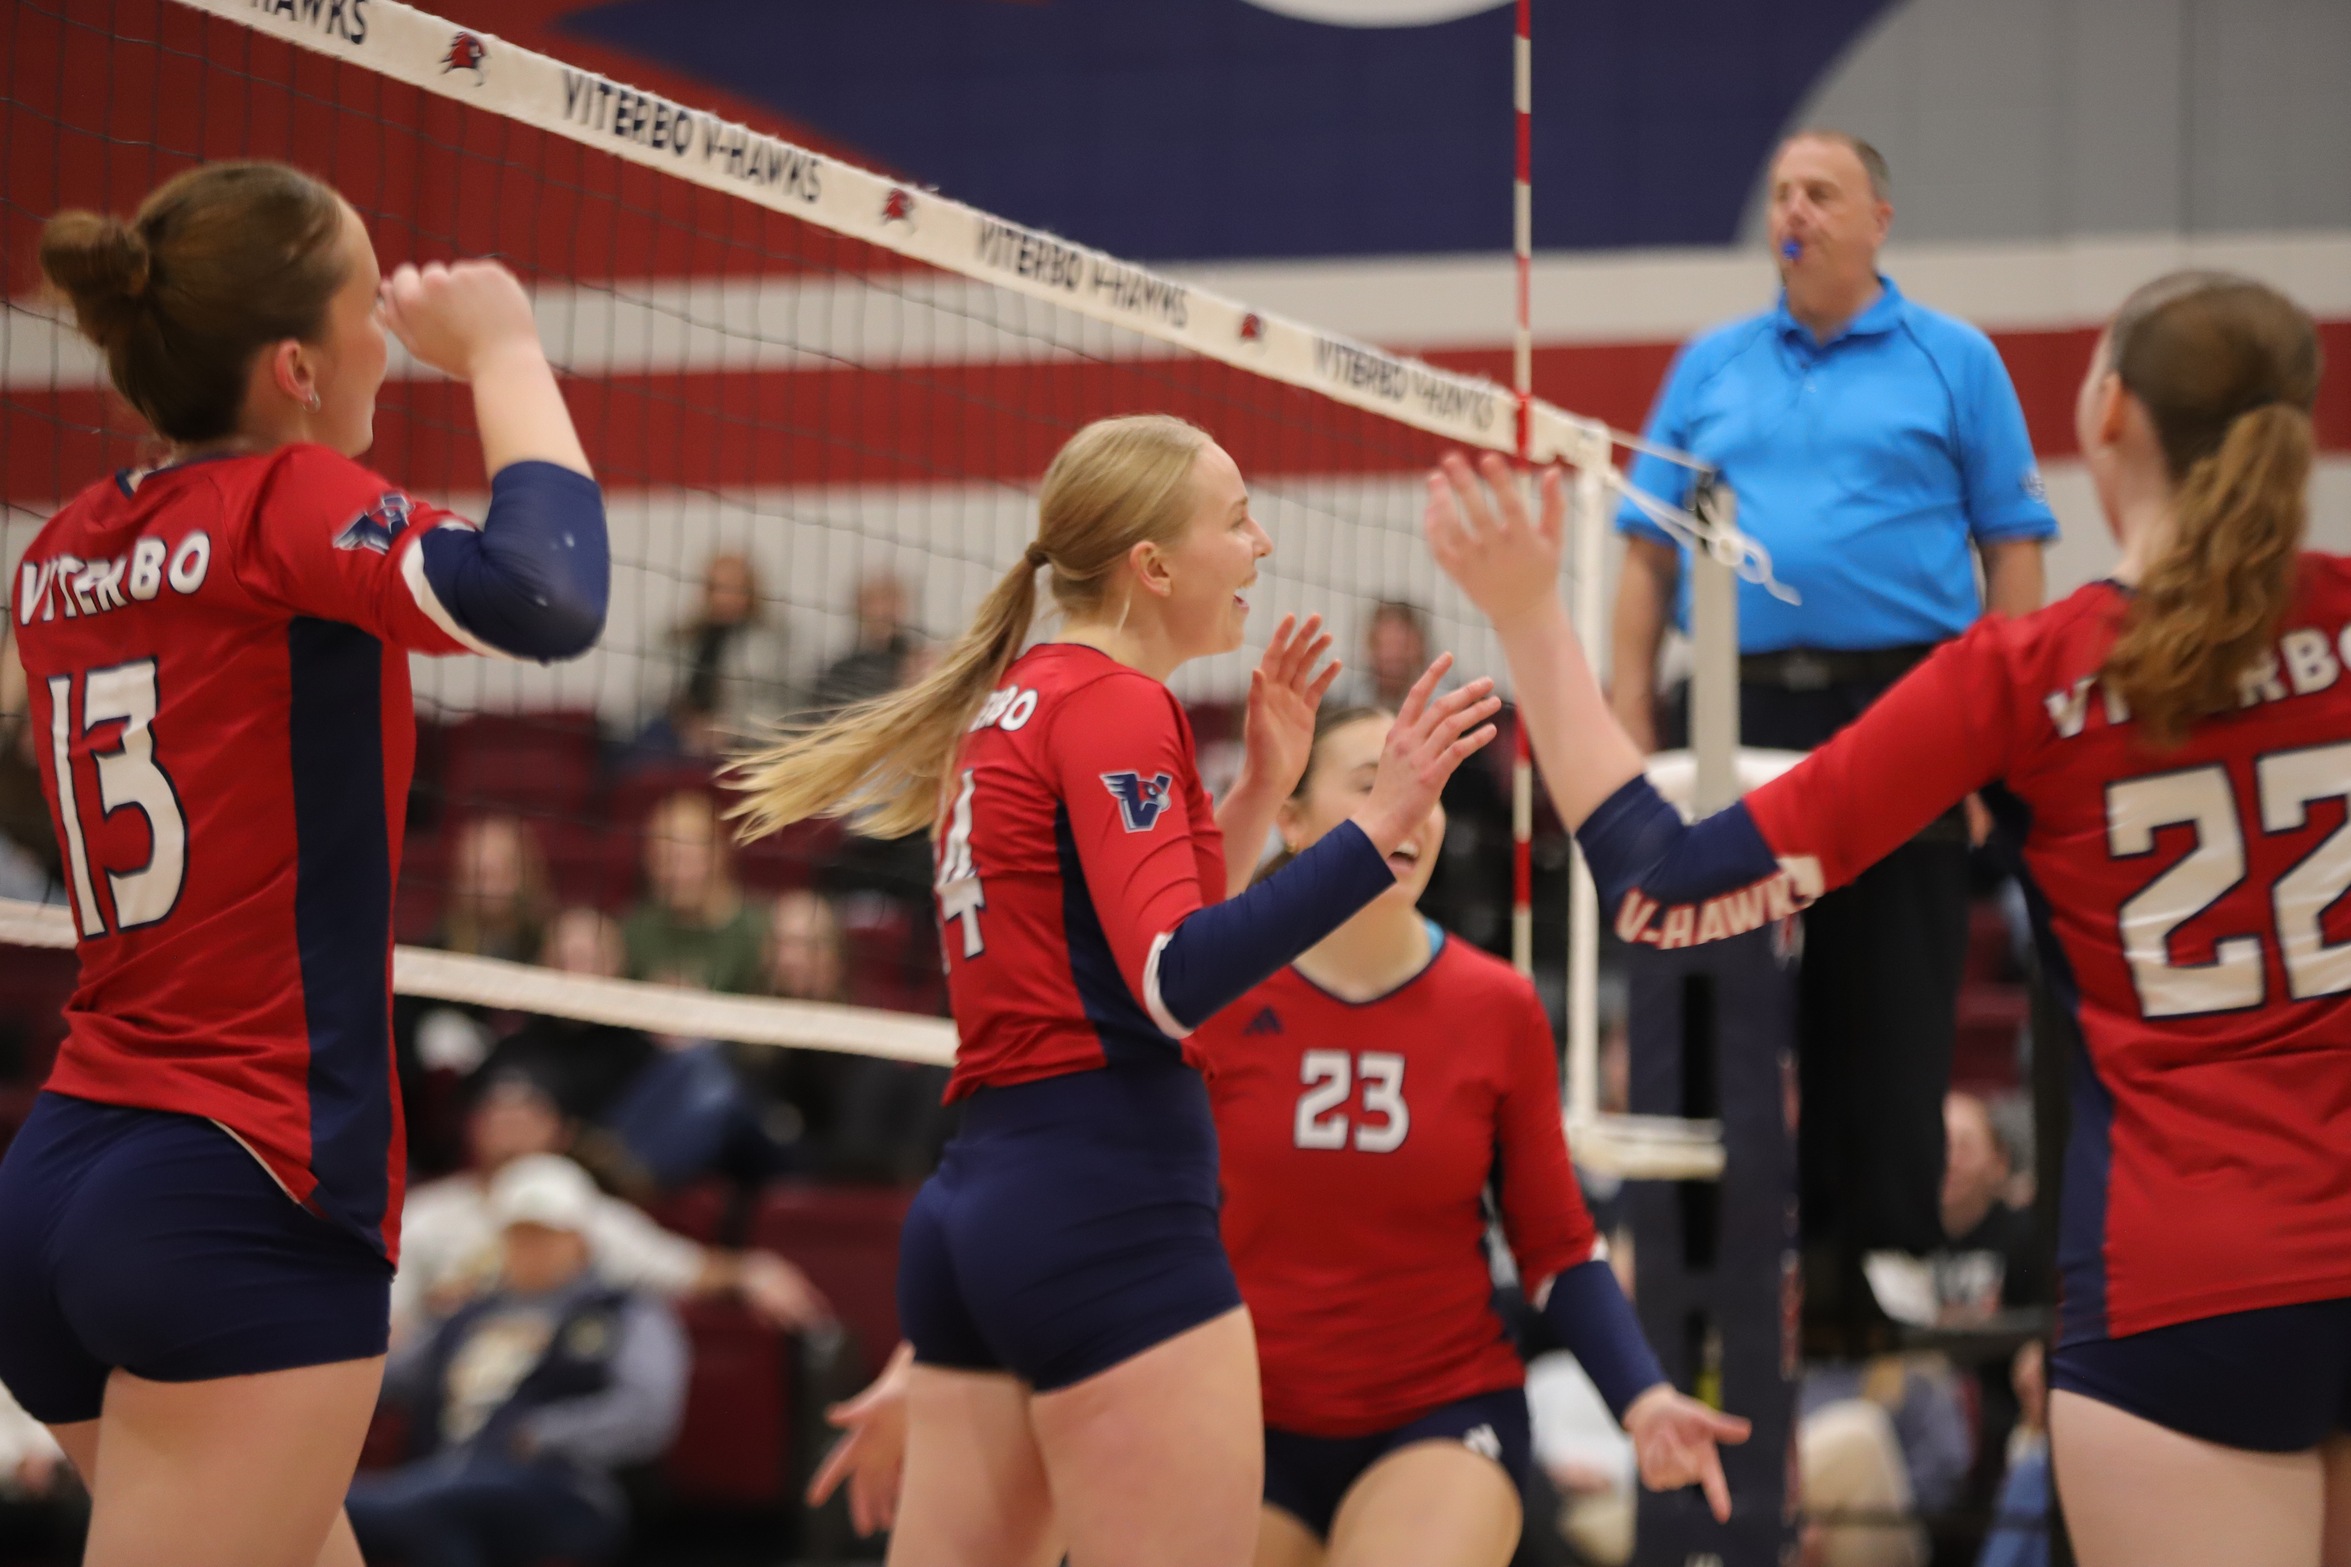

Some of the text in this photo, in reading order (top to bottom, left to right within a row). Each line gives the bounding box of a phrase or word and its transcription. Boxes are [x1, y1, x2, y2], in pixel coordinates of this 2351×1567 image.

[562, 67, 822, 204] VITERBO V-HAWKS
[19, 529, 211, 626] VITERBO
[2045, 623, 2351, 738] VIRB
[47, 656, 189, 941] 13
[2105, 742, 2351, 1021] 22
[1293, 1048, 1411, 1154] 23
